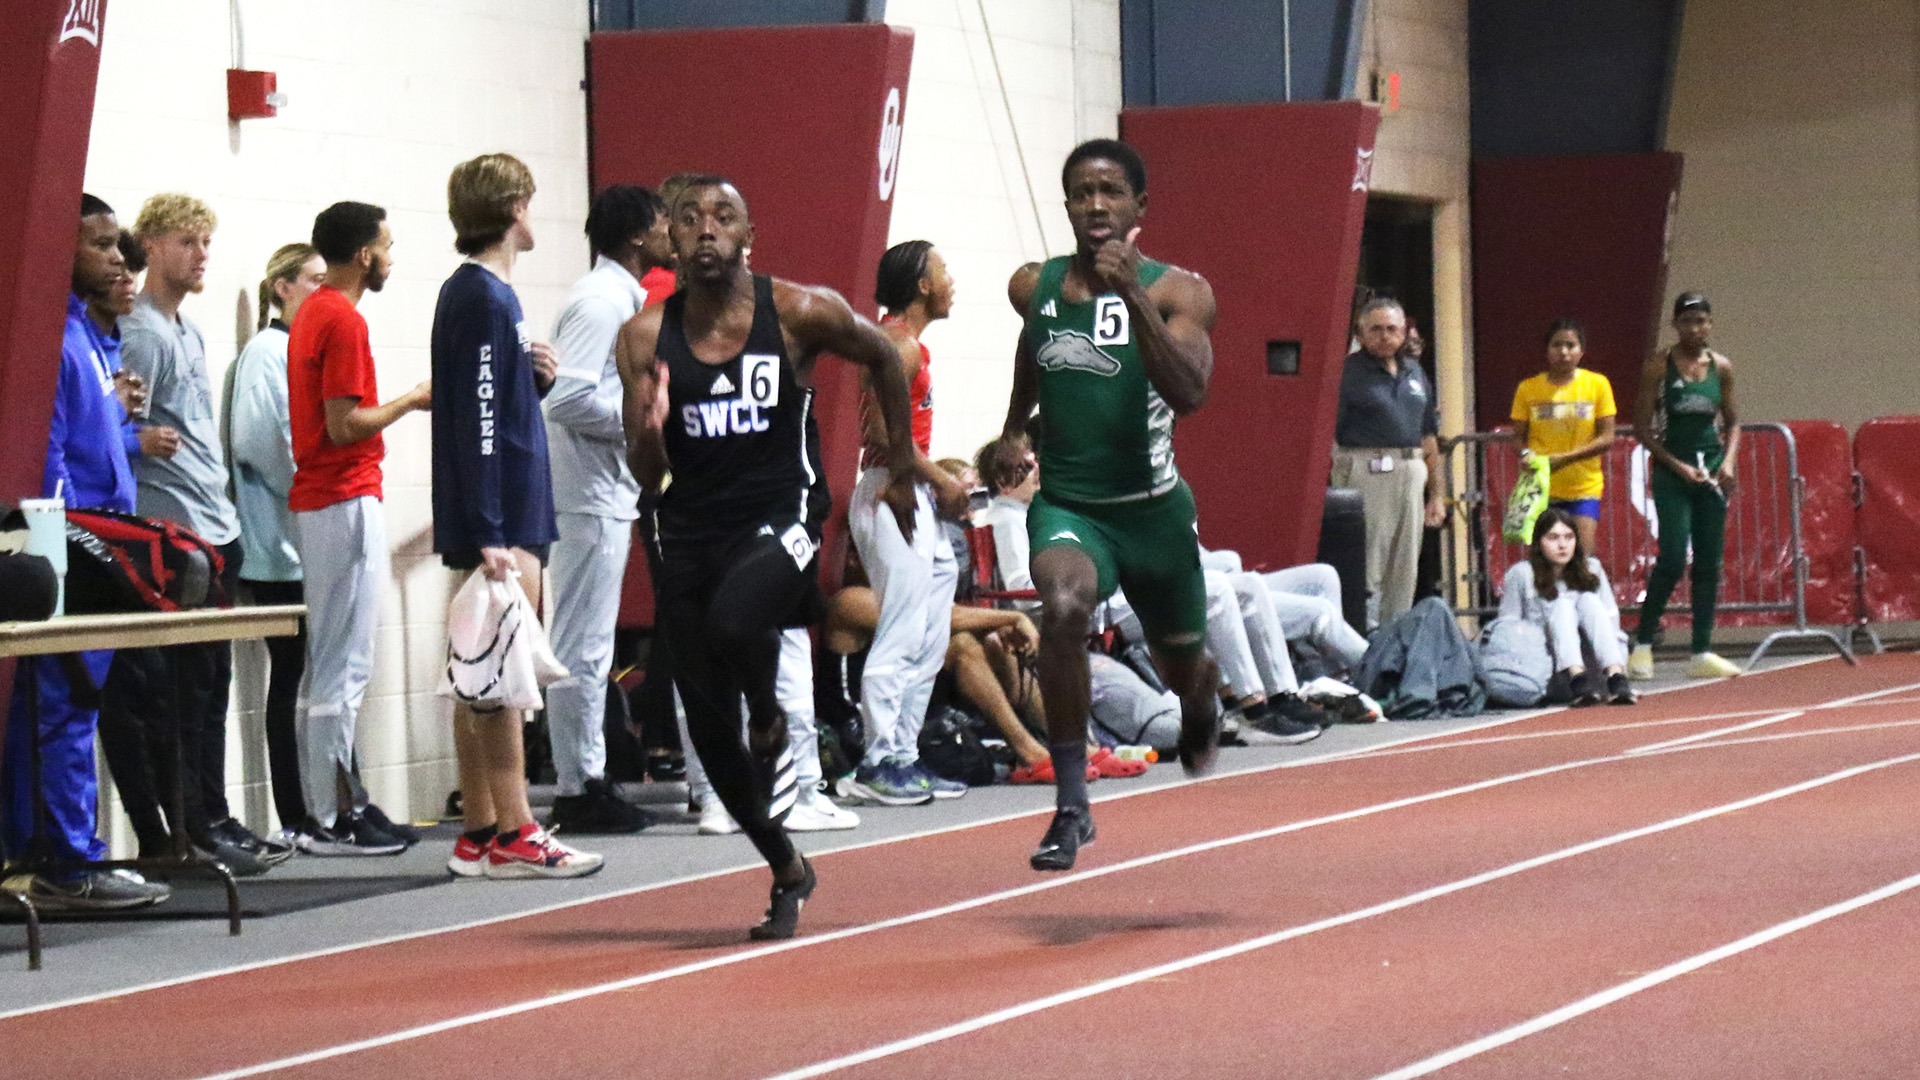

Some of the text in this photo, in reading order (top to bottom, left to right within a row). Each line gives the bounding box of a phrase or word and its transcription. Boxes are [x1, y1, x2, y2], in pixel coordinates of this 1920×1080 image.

[1099, 301, 1122, 339] 5
[477, 344, 495, 456] EAGLES
[750, 360, 771, 402] 6
[682, 399, 770, 438] SWCC
